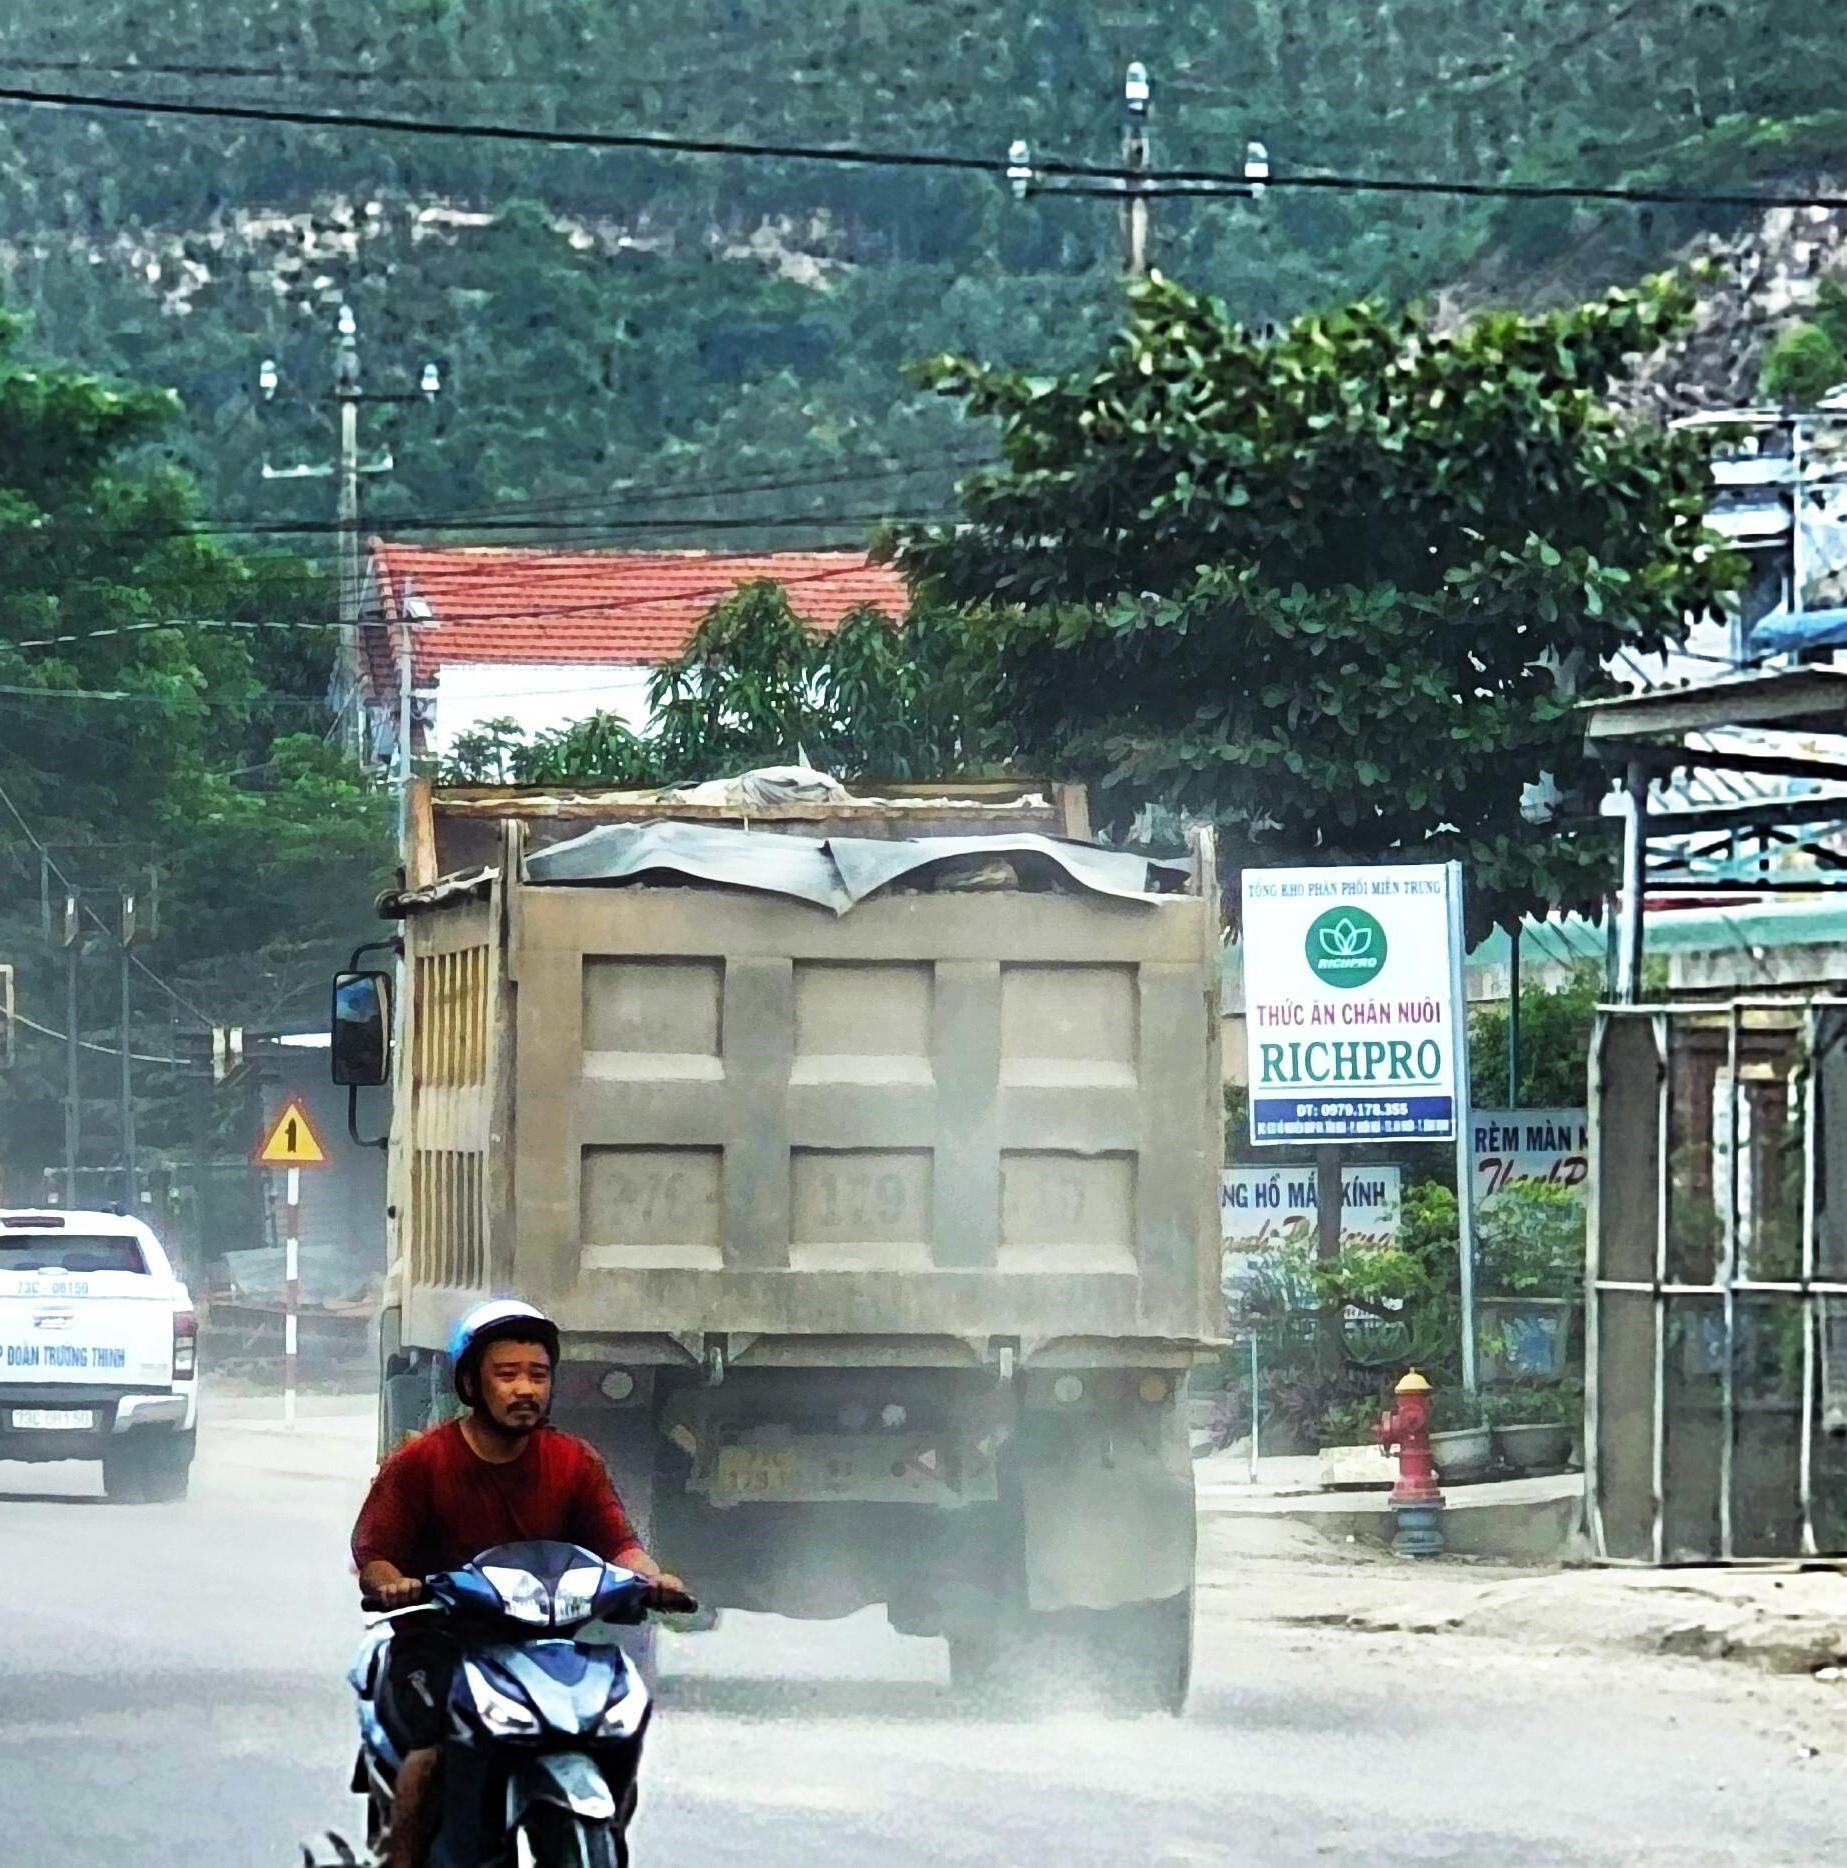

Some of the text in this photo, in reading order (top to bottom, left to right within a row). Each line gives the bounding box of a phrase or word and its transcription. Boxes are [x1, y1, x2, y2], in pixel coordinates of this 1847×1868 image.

[1317, 957, 1377, 969] RICHPRO
[1257, 997, 1441, 1026] THỨC ĂN CHĂN NUÔI
[1259, 1039, 1442, 1083] RICHPRO
[1475, 1120, 1519, 1153] RÈM
[1526, 1119, 1572, 1152] MÀN
[1255, 1172, 1281, 1208] HỒ
